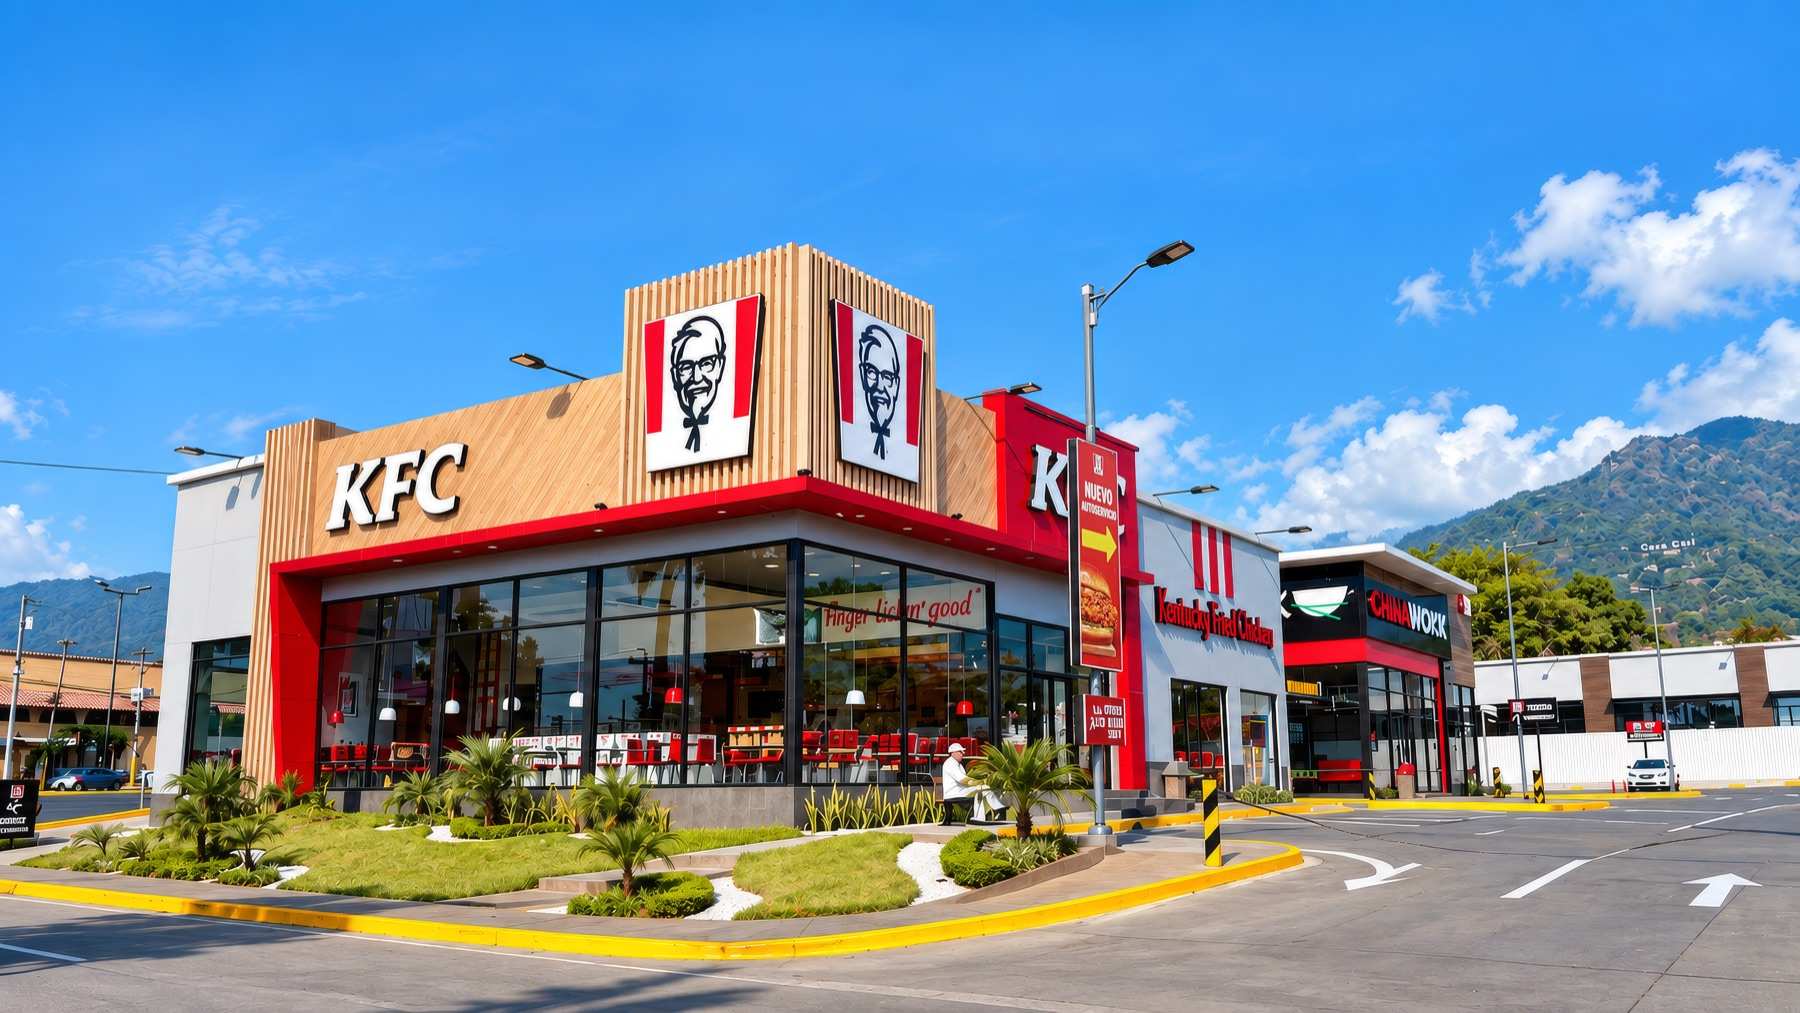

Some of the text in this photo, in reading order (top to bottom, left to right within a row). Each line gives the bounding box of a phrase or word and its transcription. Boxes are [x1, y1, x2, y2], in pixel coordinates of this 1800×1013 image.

[325, 442, 469, 532] KFC
[1084, 481, 1113, 506] NUEVO
[1081, 500, 1117, 521] AUTOSERVICIO
[928, 589, 973, 628] good
